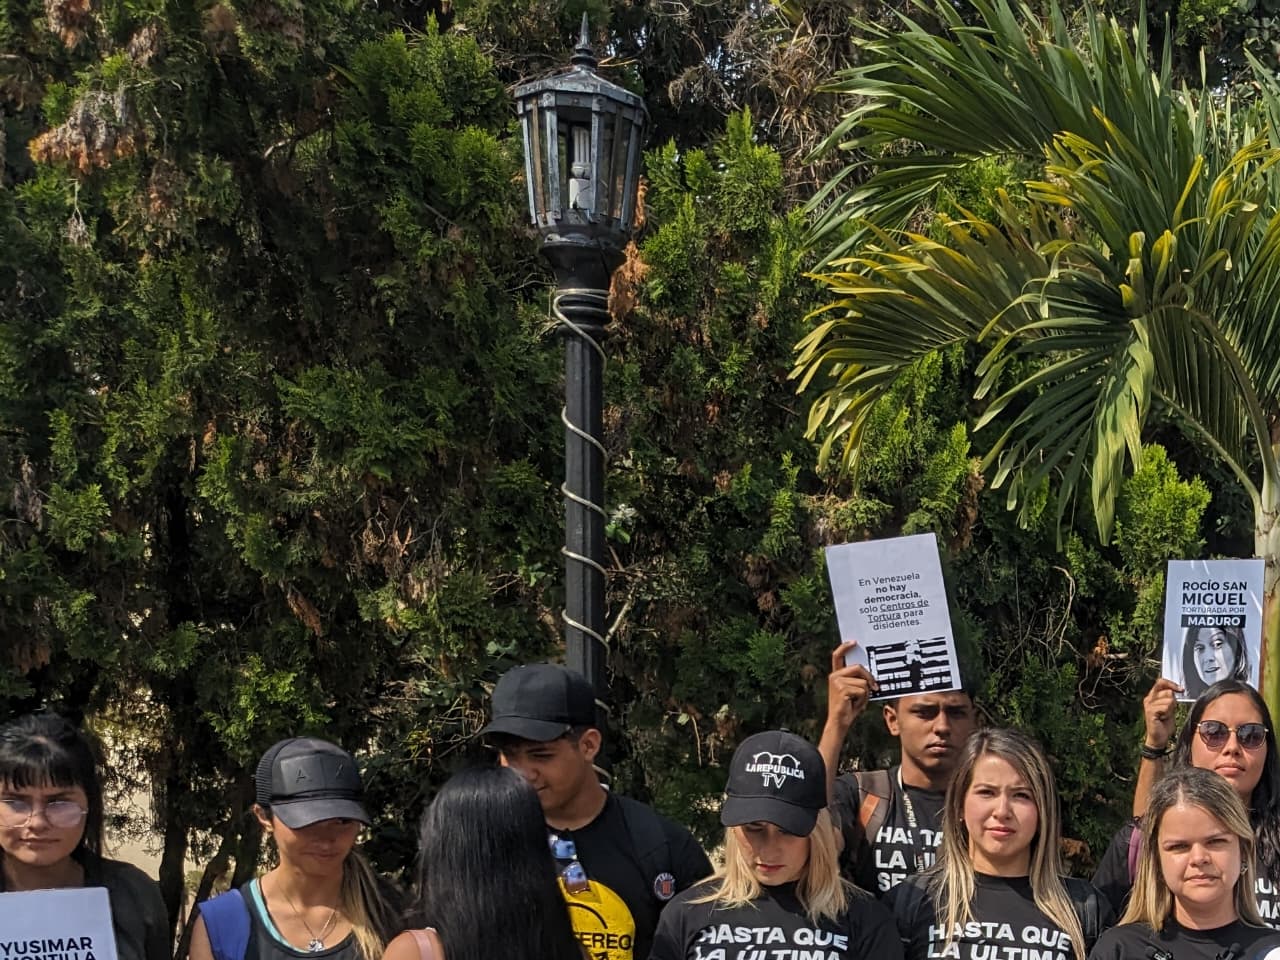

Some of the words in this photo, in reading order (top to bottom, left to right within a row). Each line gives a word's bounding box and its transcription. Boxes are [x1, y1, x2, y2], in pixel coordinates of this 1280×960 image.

[859, 579, 871, 587] En
[872, 572, 920, 585] Venezuela
[1182, 579, 1220, 591] ROCÍO
[1222, 581, 1247, 591] SAN
[889, 584, 906, 592] hay
[859, 606, 878, 614] solo
[880, 601, 915, 612] Centros
[916, 599, 929, 608] de
[1182, 592, 1247, 606] MIGUEL
[867, 612, 902, 623] Tortura
[903, 609, 924, 619] para
[1181, 606, 1228, 614] TORTURADA
[1187, 616, 1241, 626] MADURO
[761, 772, 787, 789] TV
[875, 849, 907, 870] LA
[877, 872, 907, 892] SE
[700, 924, 786, 945] HASTA
[793, 927, 849, 951] QUE
[928, 921, 1015, 942] HASTA
[1021, 926, 1073, 952] QUE
[0, 936, 93, 956] YUSIMAR
[927, 941, 961, 959] LA
